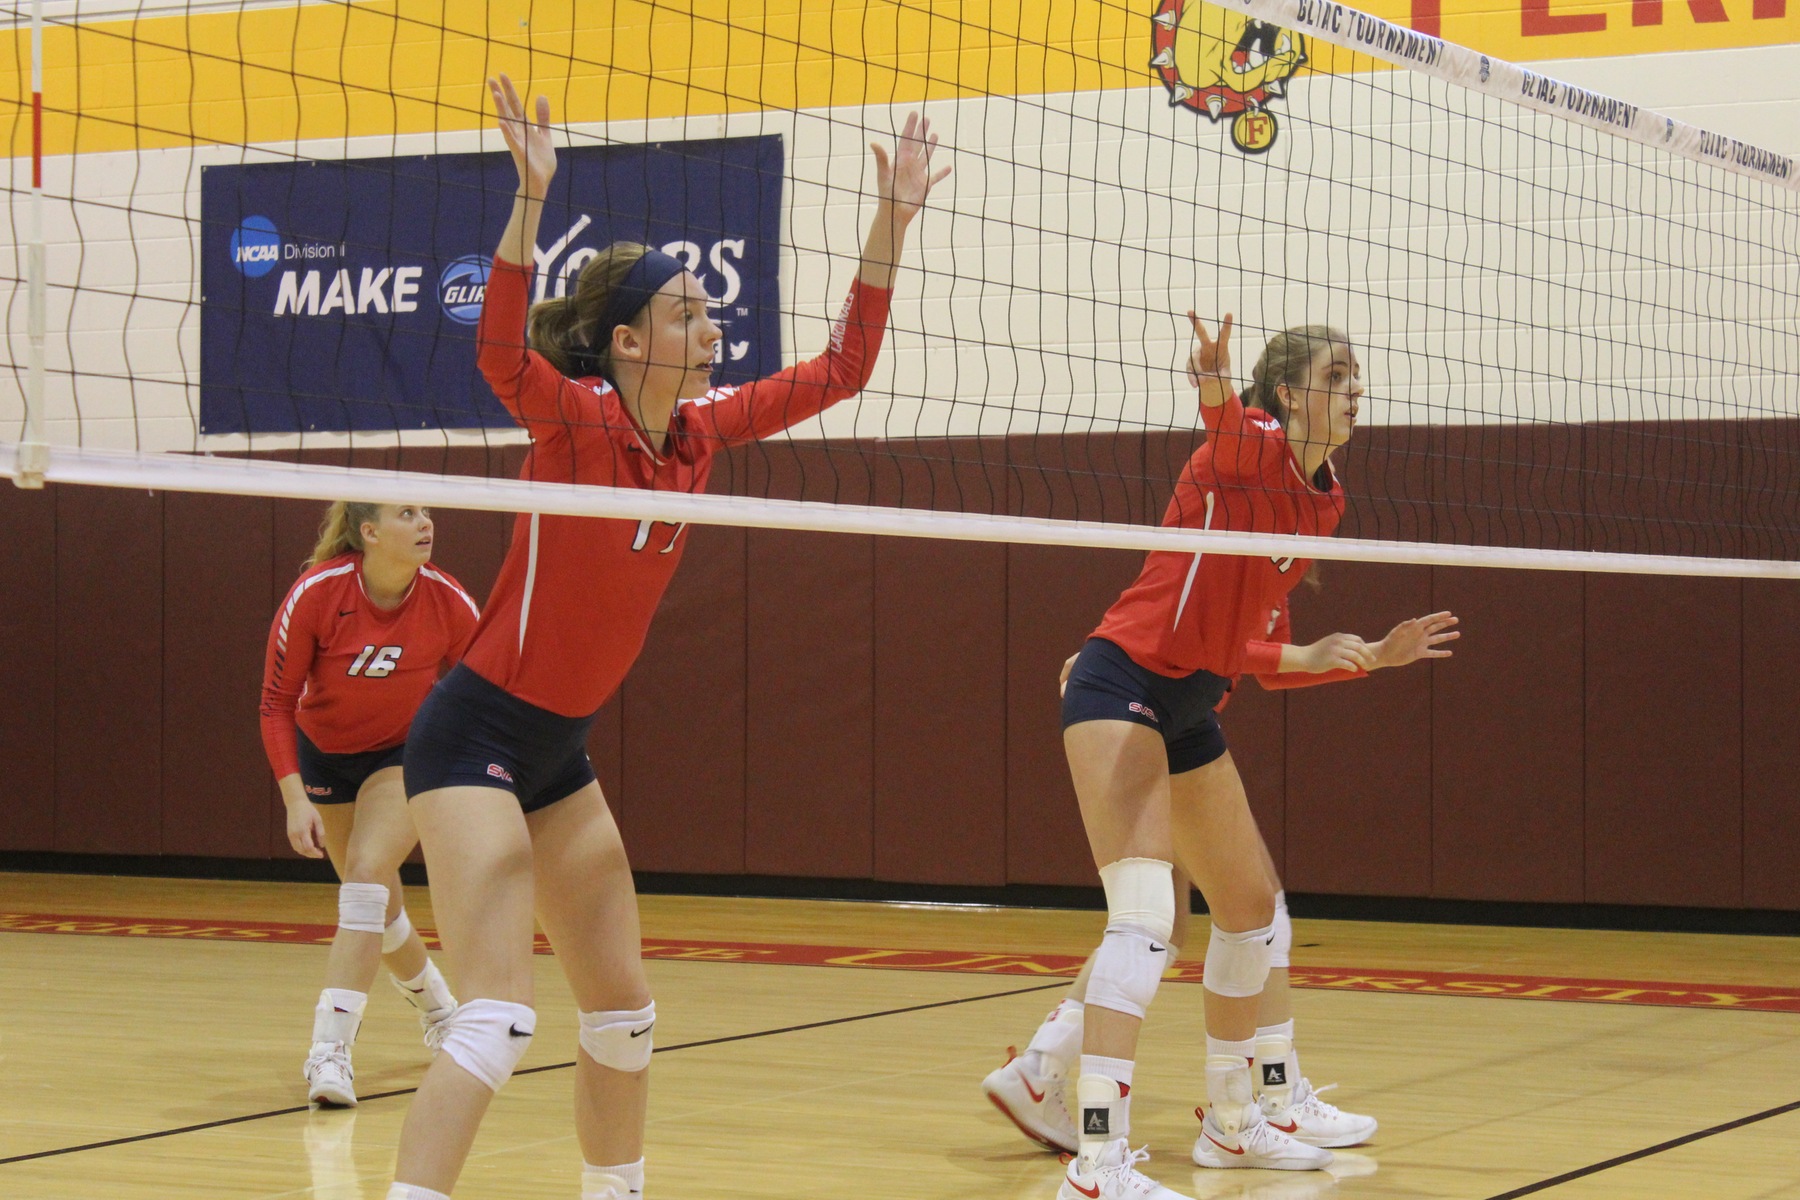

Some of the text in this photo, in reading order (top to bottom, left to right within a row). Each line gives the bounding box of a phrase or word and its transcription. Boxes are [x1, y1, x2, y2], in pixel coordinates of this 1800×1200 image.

[1297, 0, 1342, 33] GLIAC
[1348, 9, 1445, 68] TOURNAMENT
[1521, 69, 1557, 104] GLIAC
[1559, 83, 1639, 130] TOURNAMENT
[1246, 116, 1268, 145] F
[1700, 129, 1727, 159] GLIAC
[1730, 139, 1793, 180] TOURNAMENT
[236, 244, 279, 263] NCAA
[284, 242, 335, 260] Division
[273, 266, 422, 317] MAKE
[736, 308, 748, 316] TM
[347, 645, 403, 678] 16
